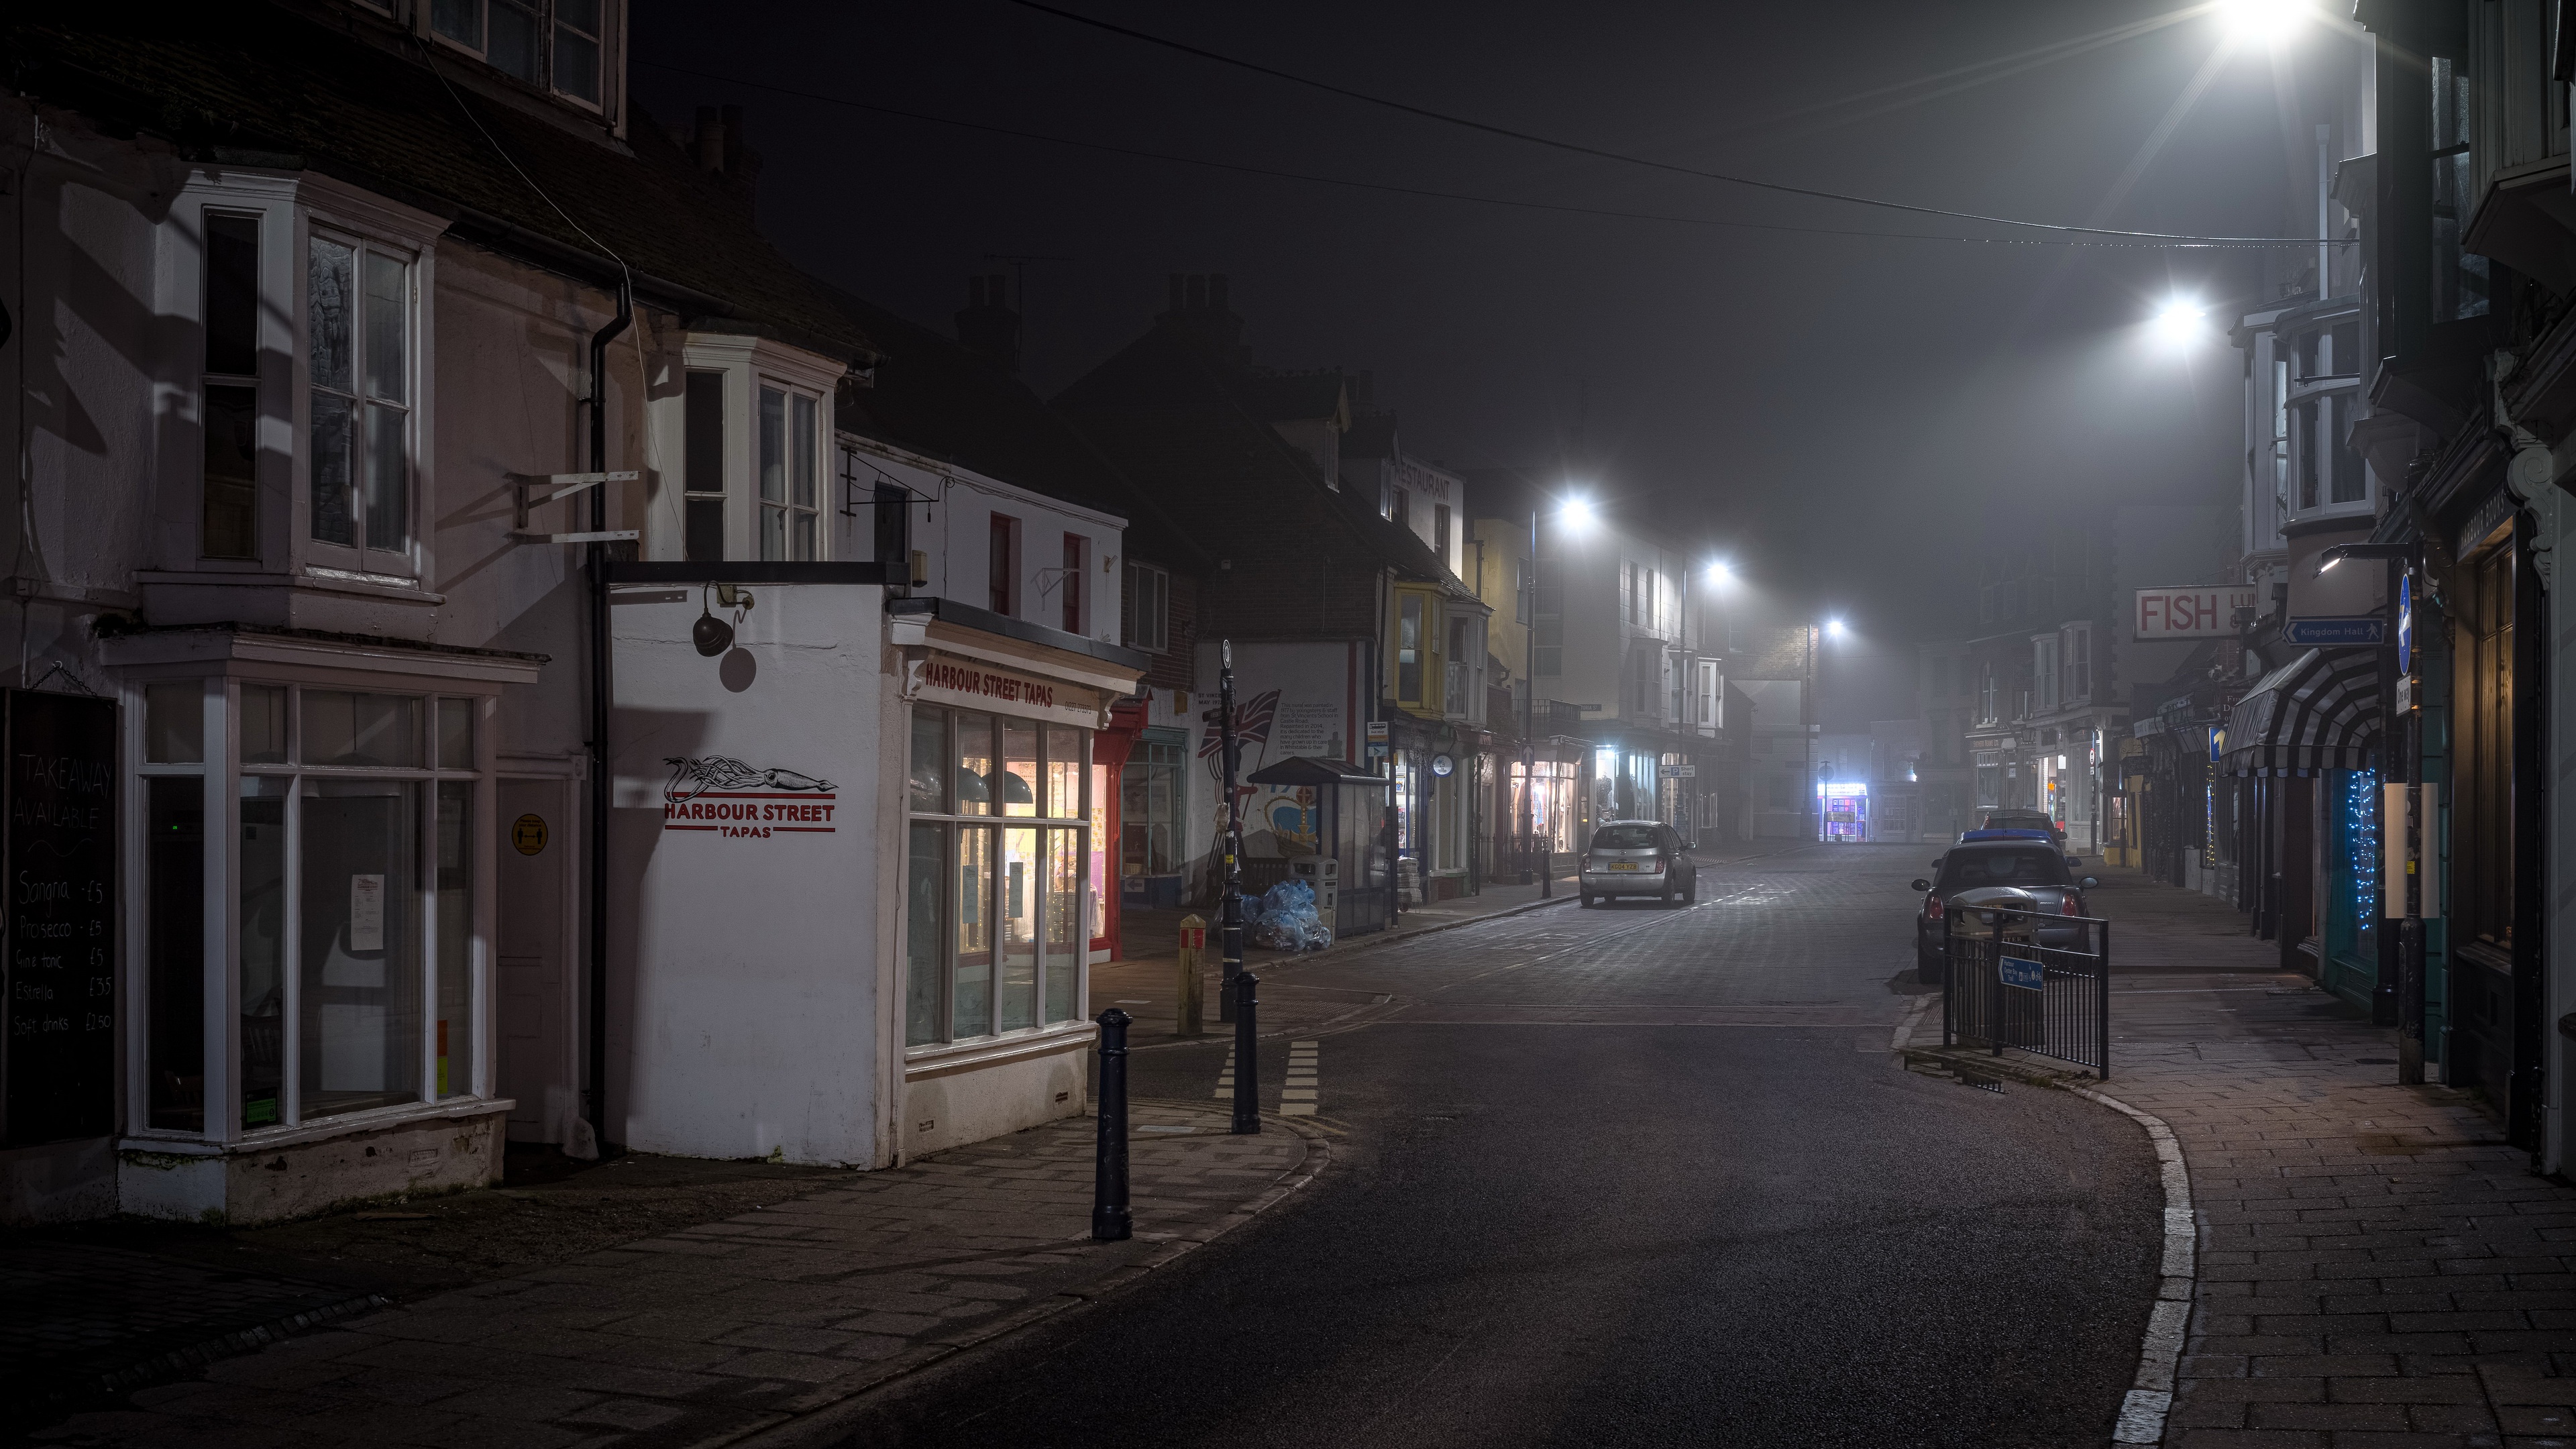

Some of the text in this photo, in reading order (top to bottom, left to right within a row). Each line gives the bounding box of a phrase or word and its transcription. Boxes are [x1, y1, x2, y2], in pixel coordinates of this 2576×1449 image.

[2461, 488, 2504, 550] HARBOUR BOOKS
[2141, 594, 2217, 631] FISH
[2301, 627, 2364, 637] Kingdom Hall
[926, 663, 1053, 708] HARBOUR STREET TAPAS
[1065, 701, 1076, 712] 01227
[19, 753, 112, 800] TAKEAWAY
[13, 796, 100, 829] AVAILABLE
[665, 803, 835, 822] HARBOUR STREET
[720, 826, 771, 839] TAPAS
[18, 871, 70, 918] Sangria
[87, 880, 103, 904] £5
[20, 915, 72, 939] Prosecco
[89, 920, 102, 936] £5
[16, 949, 30, 969] Gin
[41, 951, 64, 969] tonic
[90, 947, 103, 967] £5
[16, 981, 54, 1002] Estrella
[13, 1016, 38, 1042] Soft
[42, 1013, 69, 1032] drinks
